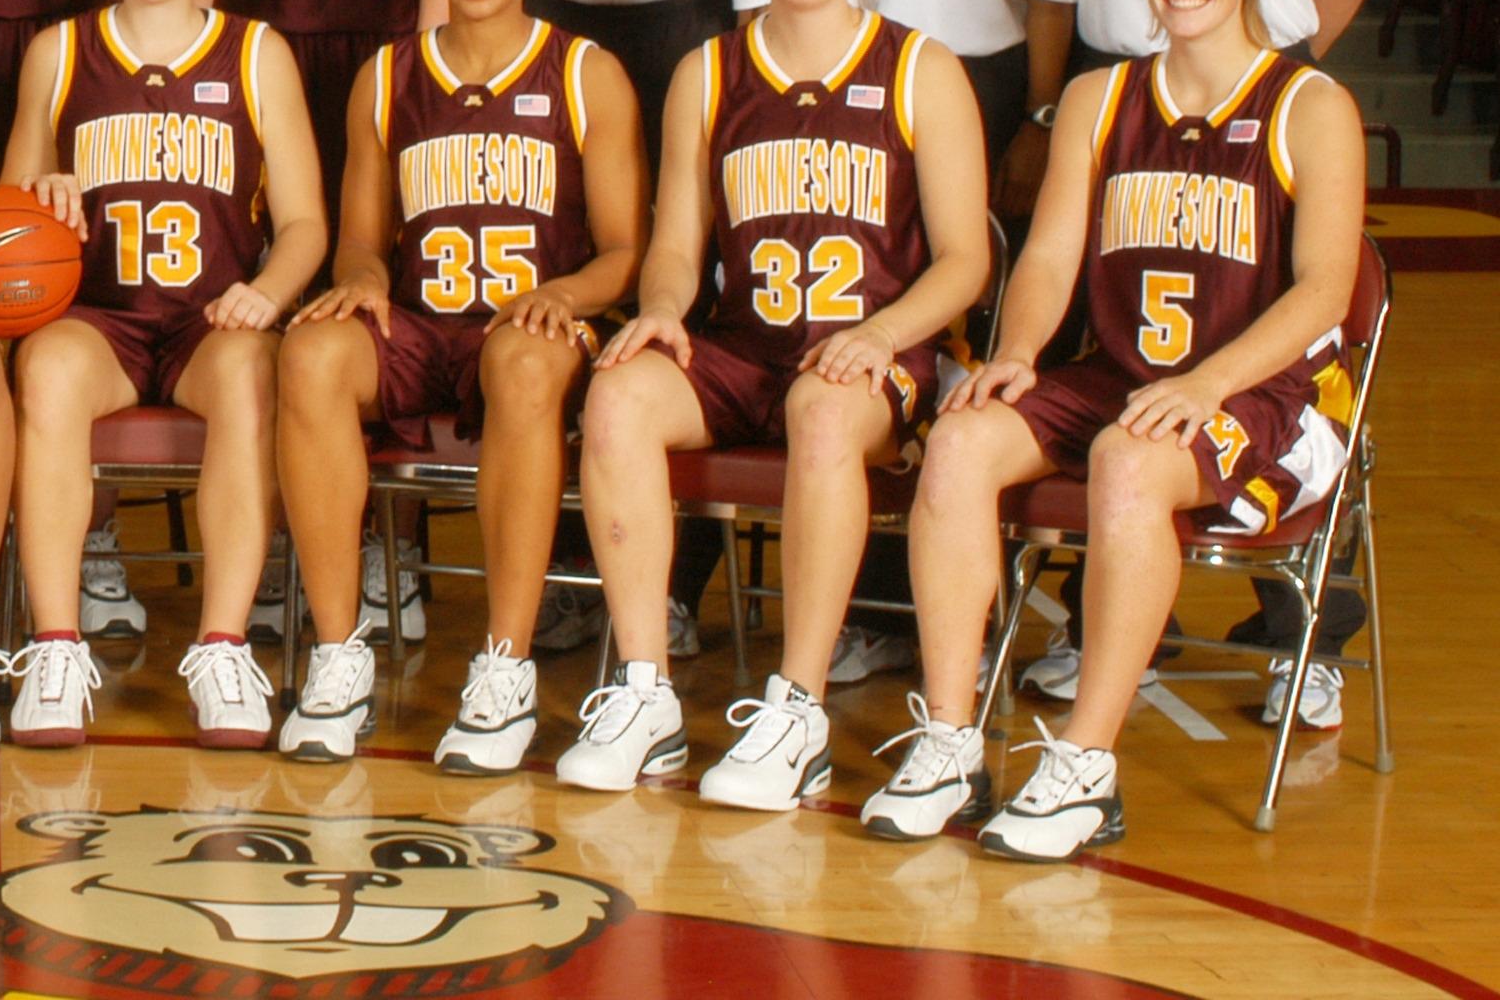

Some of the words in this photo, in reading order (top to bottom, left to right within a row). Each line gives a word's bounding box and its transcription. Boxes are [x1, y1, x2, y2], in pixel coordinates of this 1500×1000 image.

[74, 112, 235, 196] MINNESOTA
[399, 133, 557, 223] MINNESOTA
[723, 138, 886, 230] MINNESOTA
[105, 201, 202, 287] 13
[420, 225, 538, 313] 35
[750, 235, 864, 326] 32
[1138, 269, 1194, 366] 5
